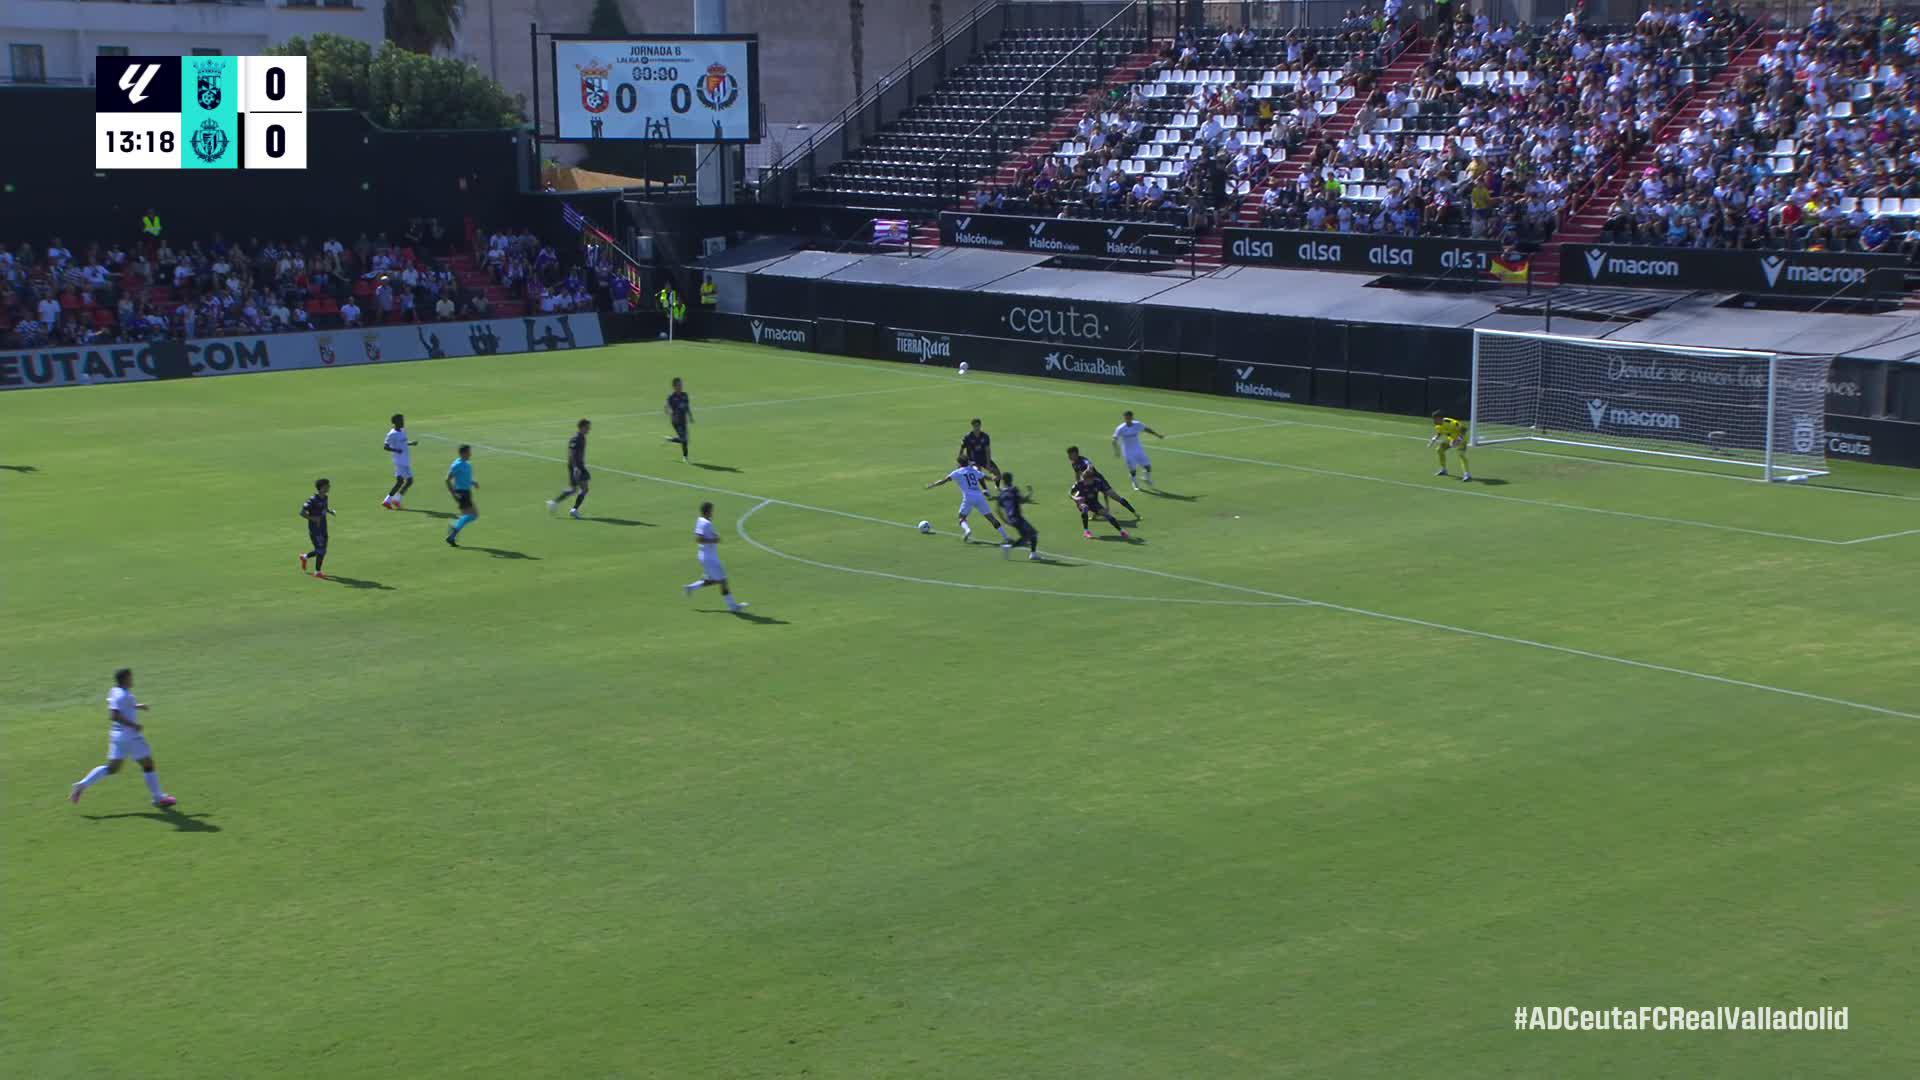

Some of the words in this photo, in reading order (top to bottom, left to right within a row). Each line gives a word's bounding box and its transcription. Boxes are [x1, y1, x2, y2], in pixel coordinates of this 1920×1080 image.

[630, 46, 672, 56] JORNADA
[616, 83, 638, 114] 0
[670, 83, 692, 114] 0
[955, 232, 988, 245] Halcón
[1029, 237, 1062, 250] Halcón
[1232, 237, 1274, 257] alsa
[1107, 242, 1141, 255] Halcón
[1298, 241, 1341, 262] alsa
[1369, 245, 1413, 265] alsa
[1608, 256, 1679, 277] macron
[1787, 264, 1865, 283] macron
[764, 326, 806, 343] macron
[1063, 353, 1127, 377] CaixaBank
[1235, 381, 1273, 396] Halcón
[1609, 407, 1681, 429] macron
[1829, 438, 1872, 455] Ceuta
[963, 472, 978, 488] 19
